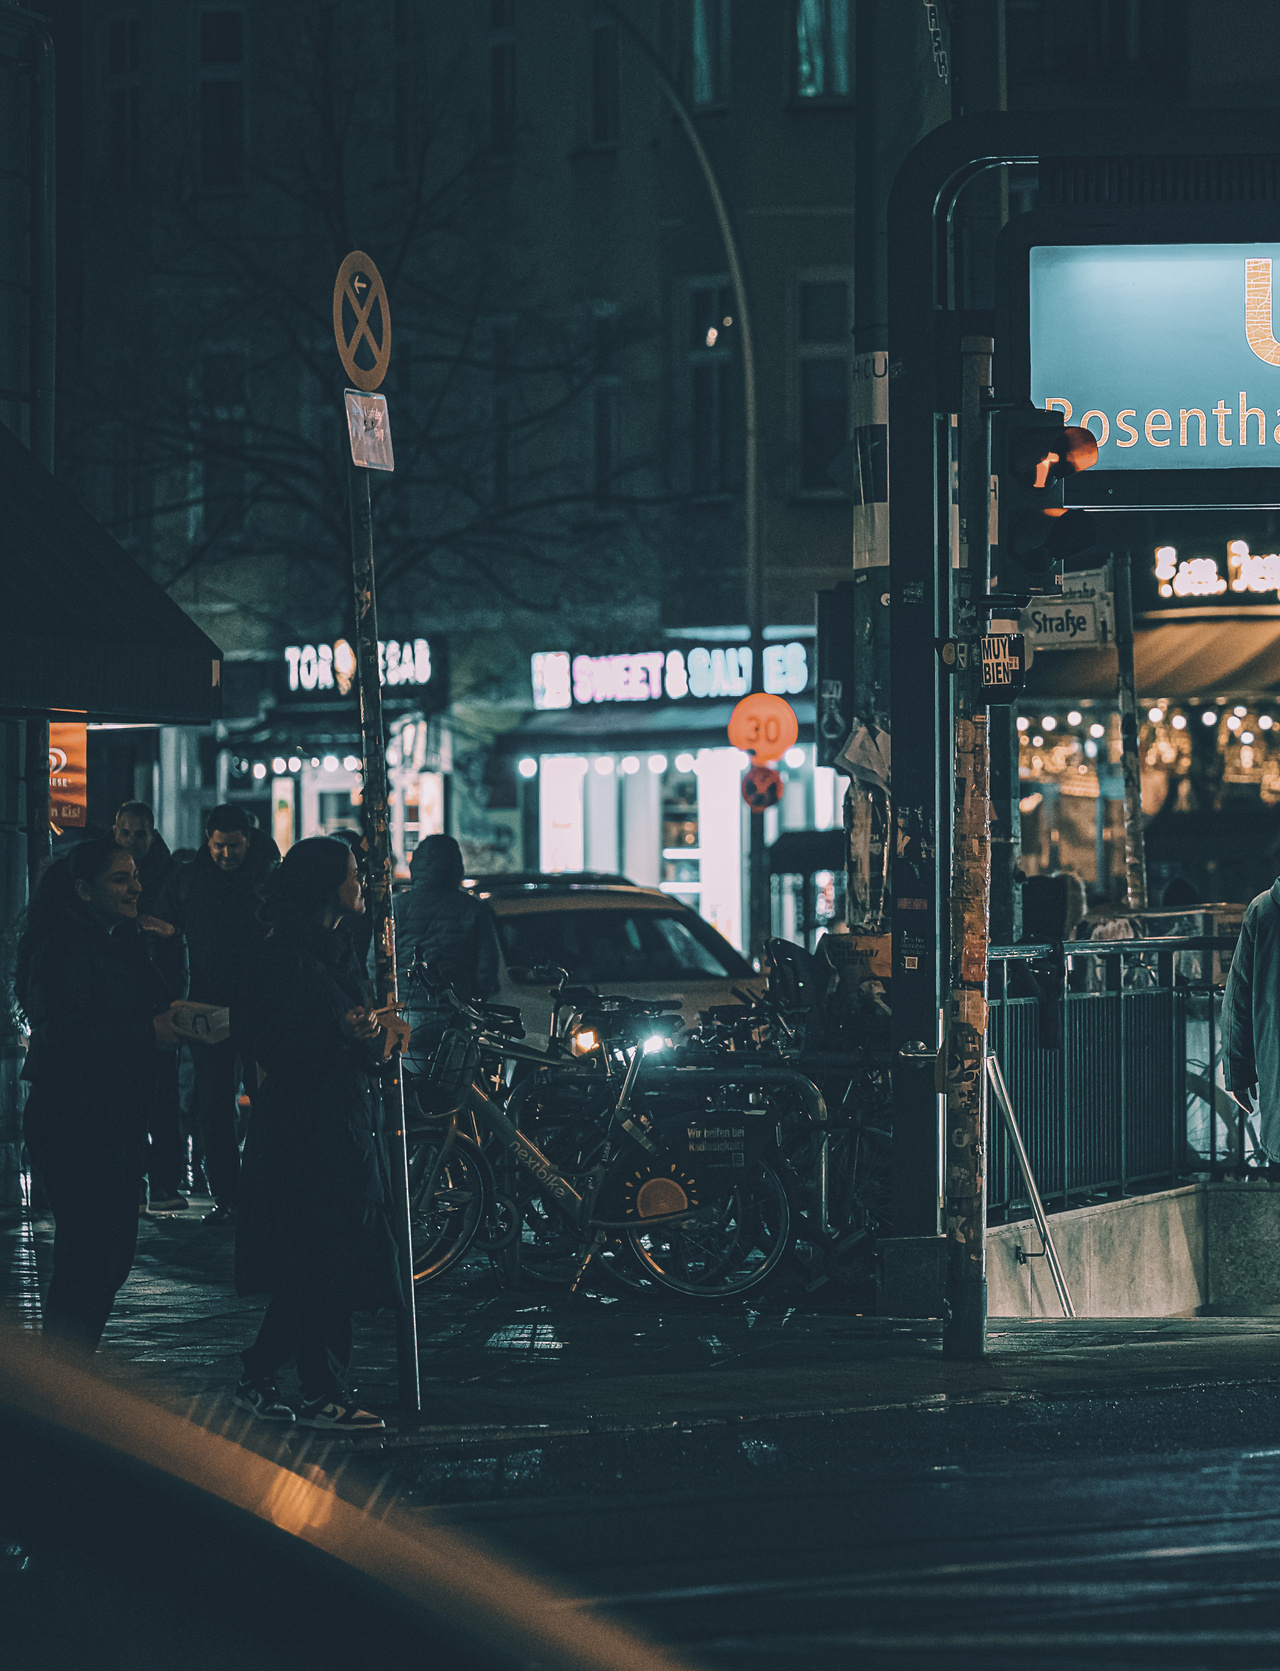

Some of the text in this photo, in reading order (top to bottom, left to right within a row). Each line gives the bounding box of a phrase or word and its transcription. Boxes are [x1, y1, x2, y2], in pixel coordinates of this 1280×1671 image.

[1031, 608, 1087, 638] Straße
[982, 640, 1008, 662] MUY
[285, 644, 334, 691] TOR
[572, 651, 665, 704] SWEET
[665, 650, 688, 700] &
[687, 641, 809, 698] SALTES
[984, 661, 1011, 684] BIEN
[746, 716, 782, 744] 30
[686, 1126, 745, 1139] Wir helfen bei
[508, 1140, 566, 1199] nextbike
